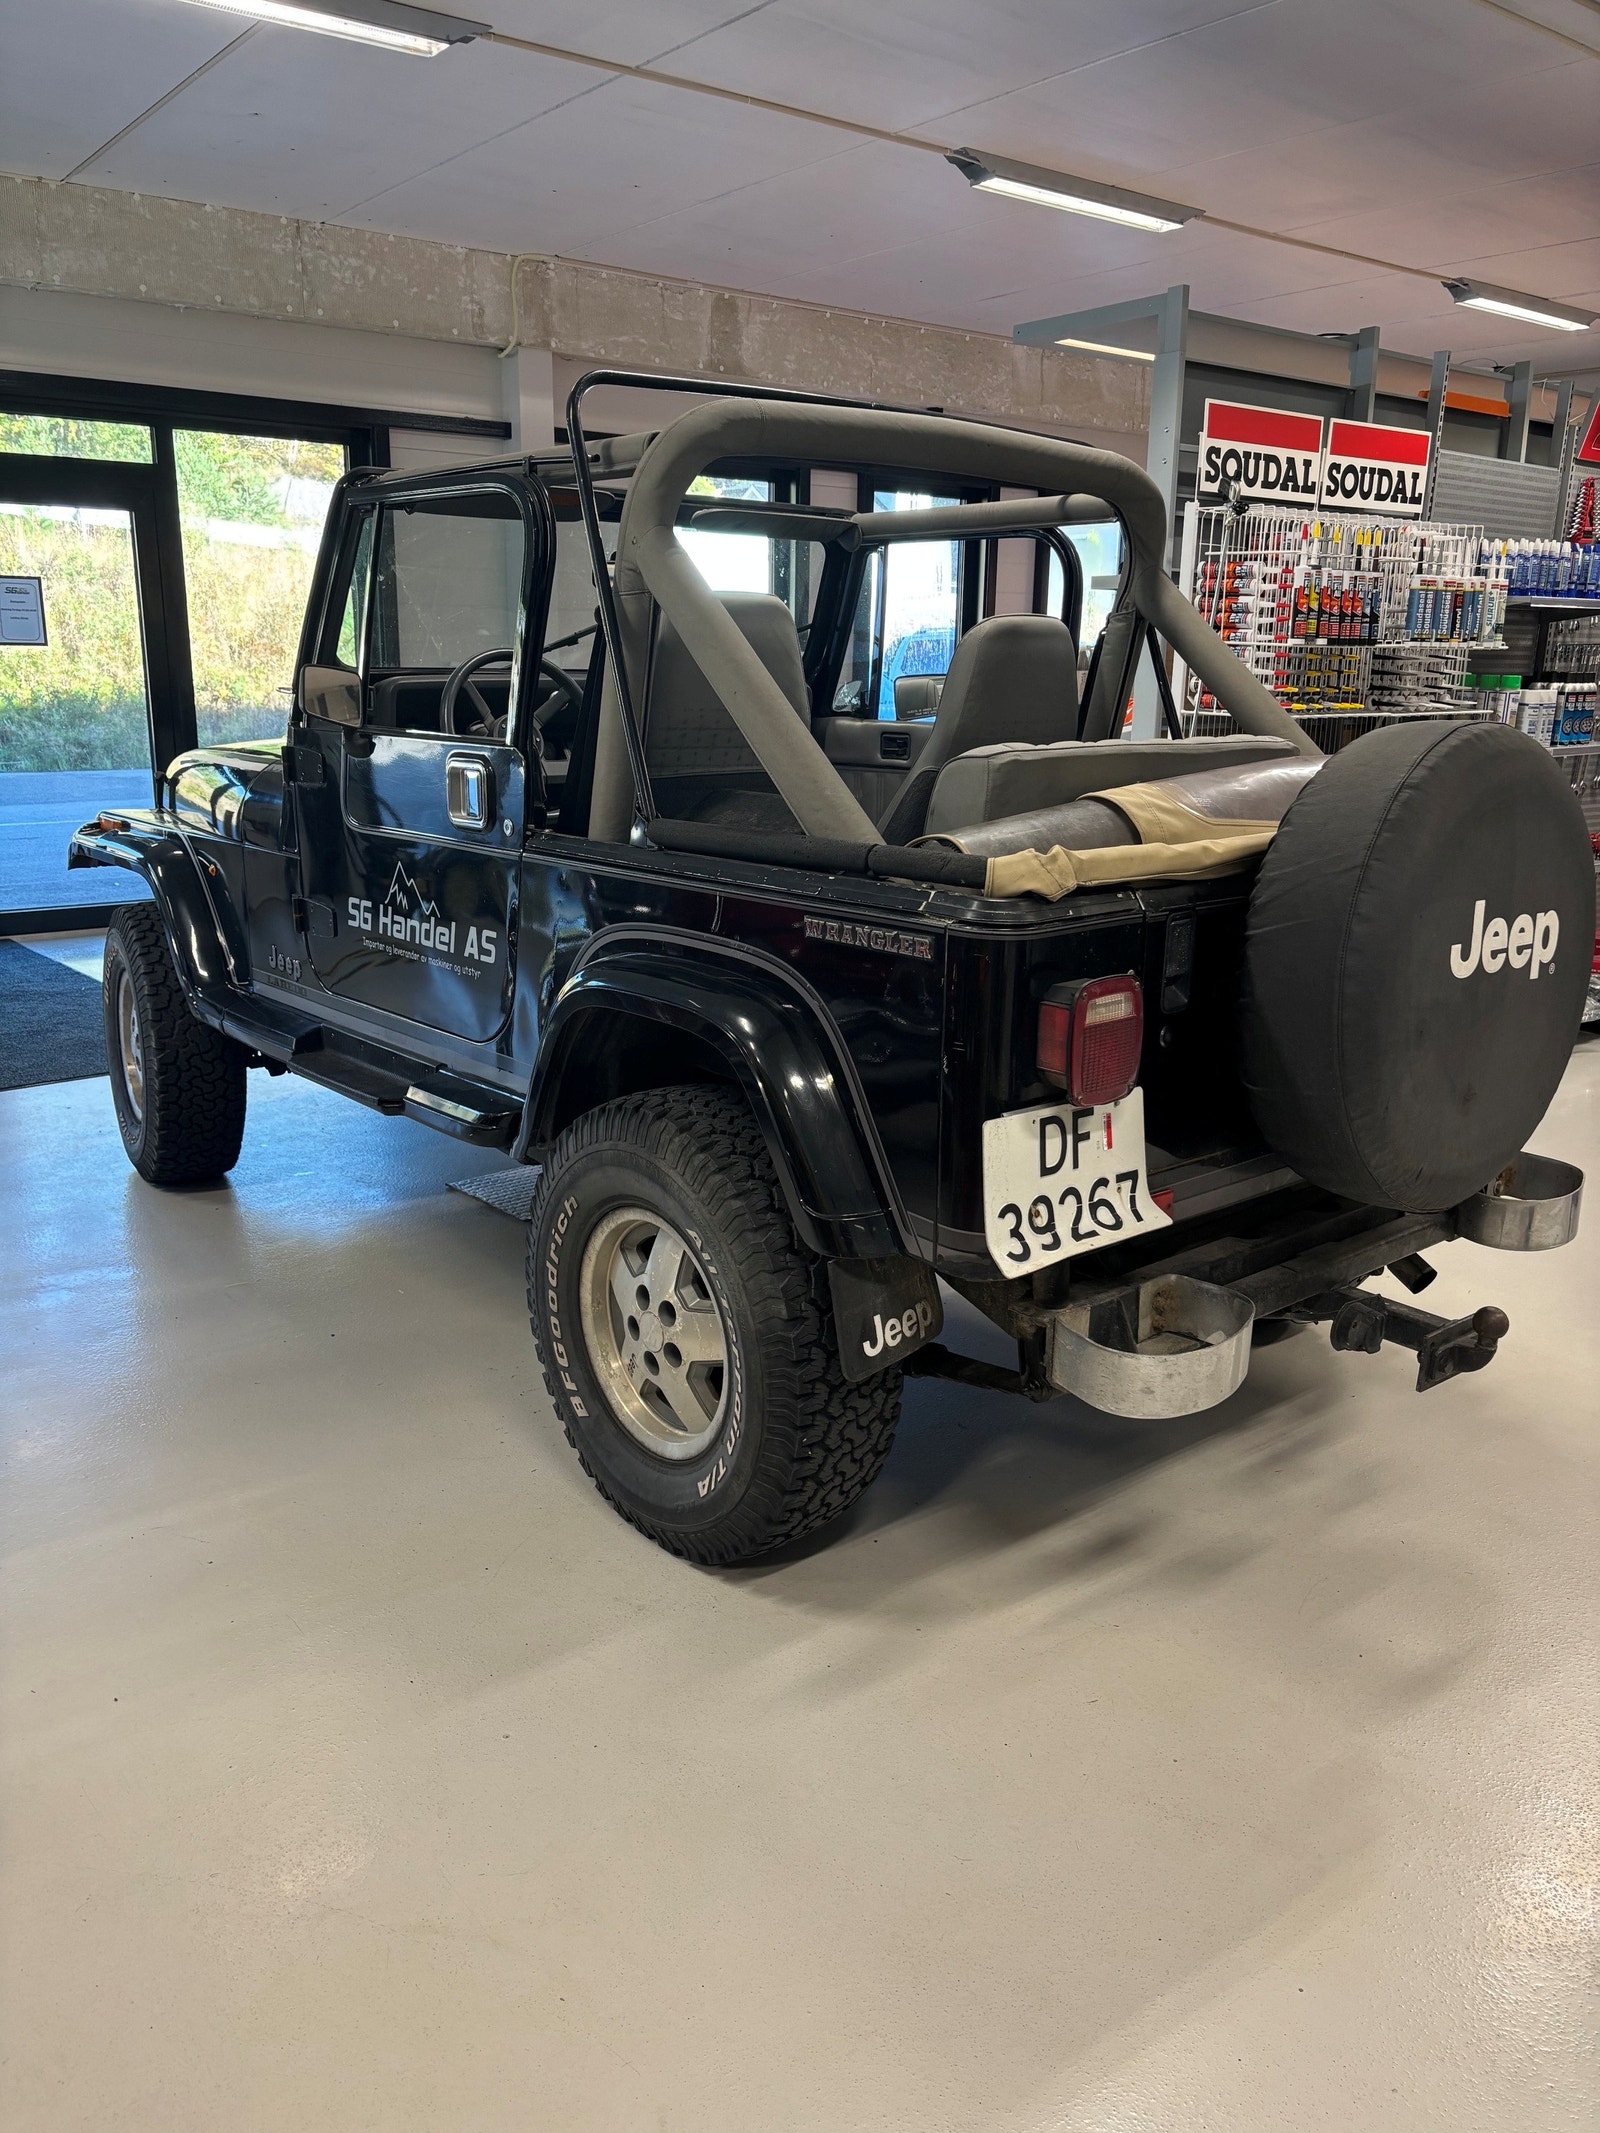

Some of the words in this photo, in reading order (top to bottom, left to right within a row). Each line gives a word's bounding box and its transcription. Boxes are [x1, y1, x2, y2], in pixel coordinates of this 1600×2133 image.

[1204, 446, 1316, 495] SOUDAL
[1326, 461, 1423, 505] SOUDAL
[1422, 591, 1433, 635] Soudaseal
[347, 896, 372, 931] SG
[378, 903, 456, 954] Handel
[463, 925, 498, 964] AS
[803, 914, 932, 959] WRANGLER
[1450, 899, 1560, 980] Jeep
[269, 944, 302, 982] Jeep
[386, 945, 392, 955] og
[420, 955, 427, 963] av
[428, 957, 453, 970] maskiner
[453, 964, 460, 976] og
[462, 966, 481, 980] utstyr
[1039, 1106, 1095, 1178] DF
[998, 1169, 1144, 1263] 39267
[544, 1195, 590, 1419] BFGoodrich
[862, 1300, 933, 1358] Jeep
[685, 1227, 742, 1456] All-Terrain
[696, 1457, 728, 1498] T/A
